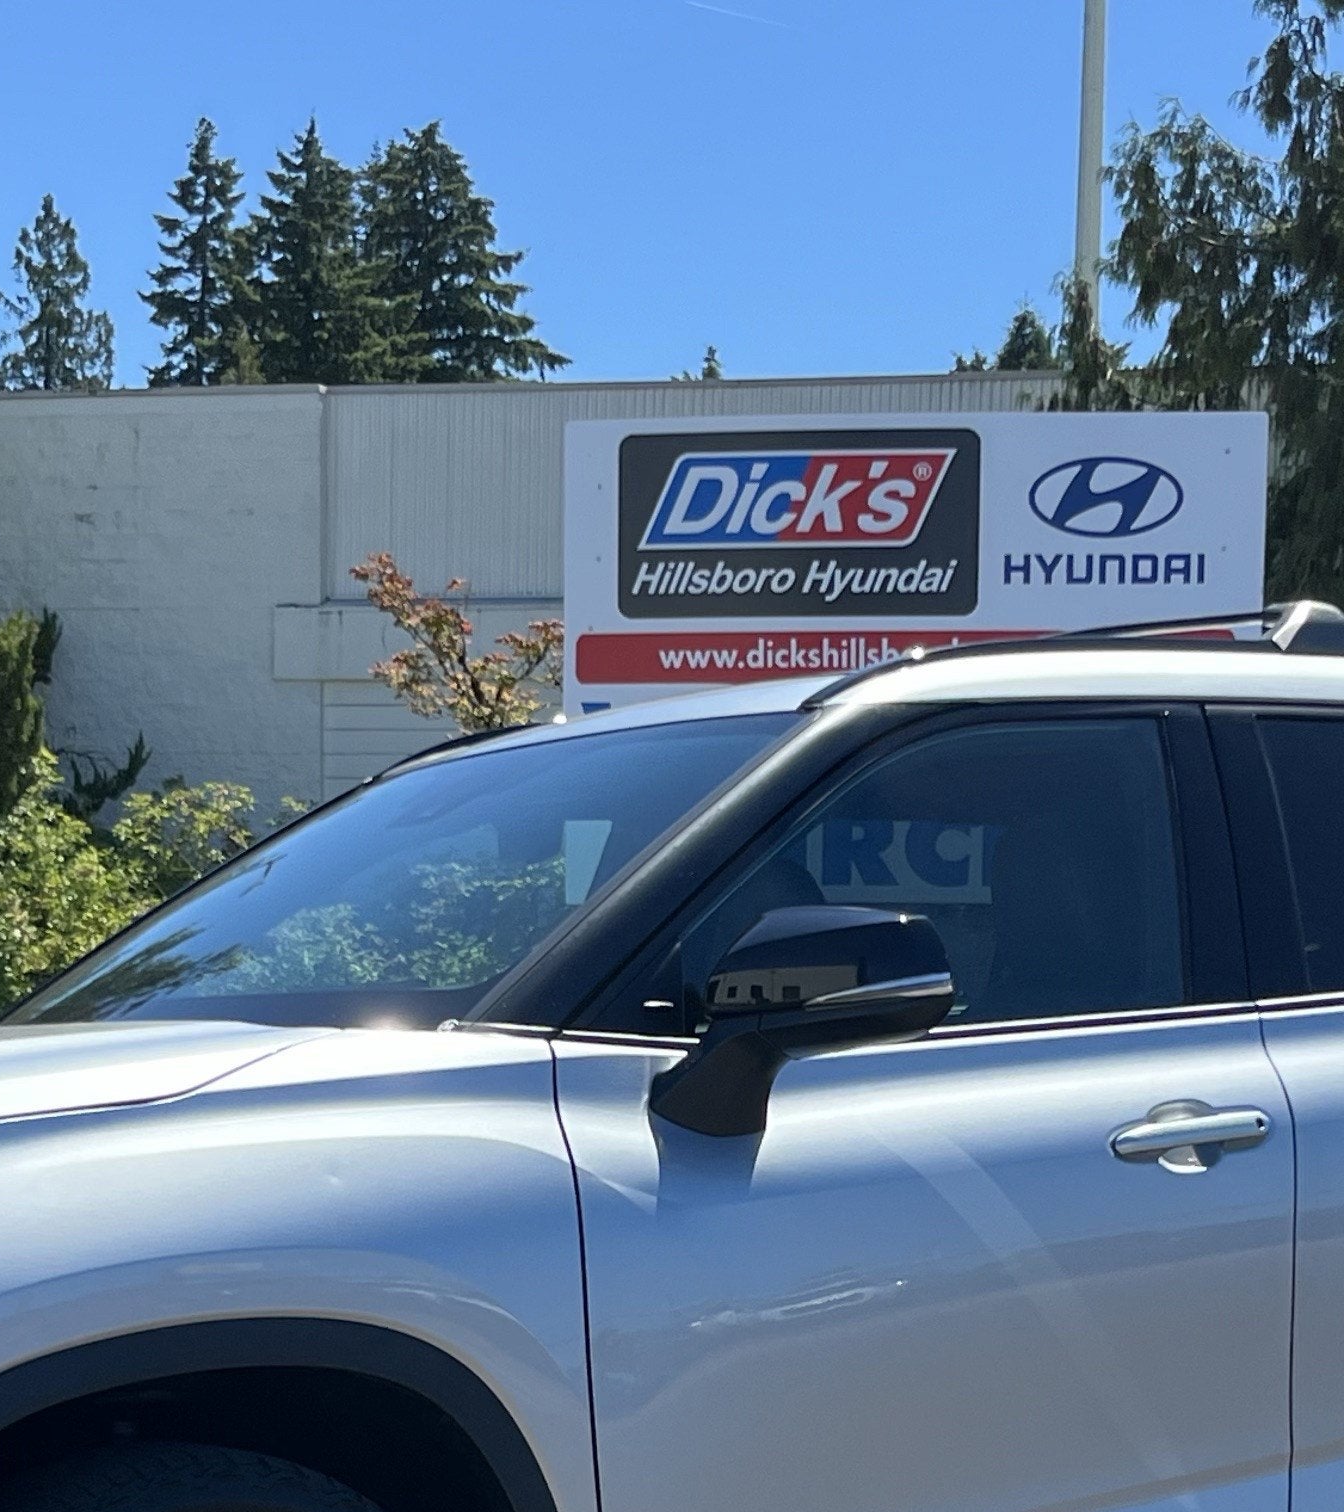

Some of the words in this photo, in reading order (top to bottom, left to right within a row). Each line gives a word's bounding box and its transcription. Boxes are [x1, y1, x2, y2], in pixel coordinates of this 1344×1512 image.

[631, 560, 796, 595] Hillsboro
[801, 559, 958, 603] Hyundai
[1003, 553, 1207, 586] HYUNDAI
[659, 637, 909, 670] www.dickshillsb
